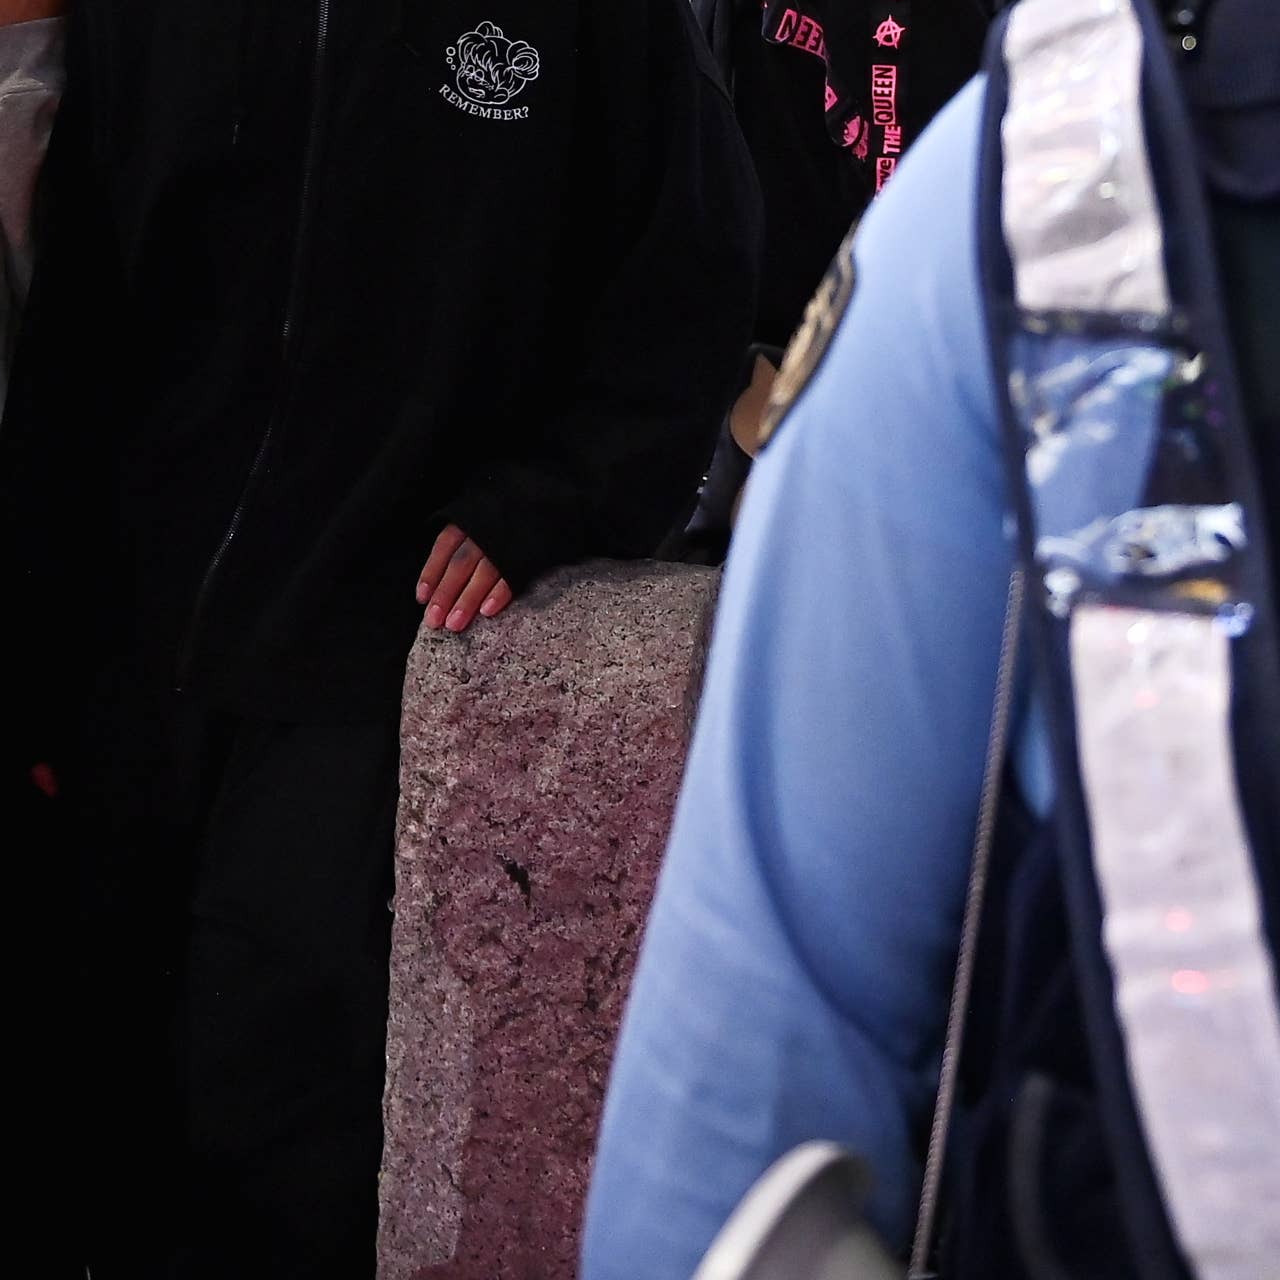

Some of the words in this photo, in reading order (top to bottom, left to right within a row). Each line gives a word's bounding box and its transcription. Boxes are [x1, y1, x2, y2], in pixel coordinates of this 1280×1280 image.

[439, 84, 529, 120] REMEMBER?
[872, 65, 896, 125] QUEEN
[883, 124, 901, 154] THE
